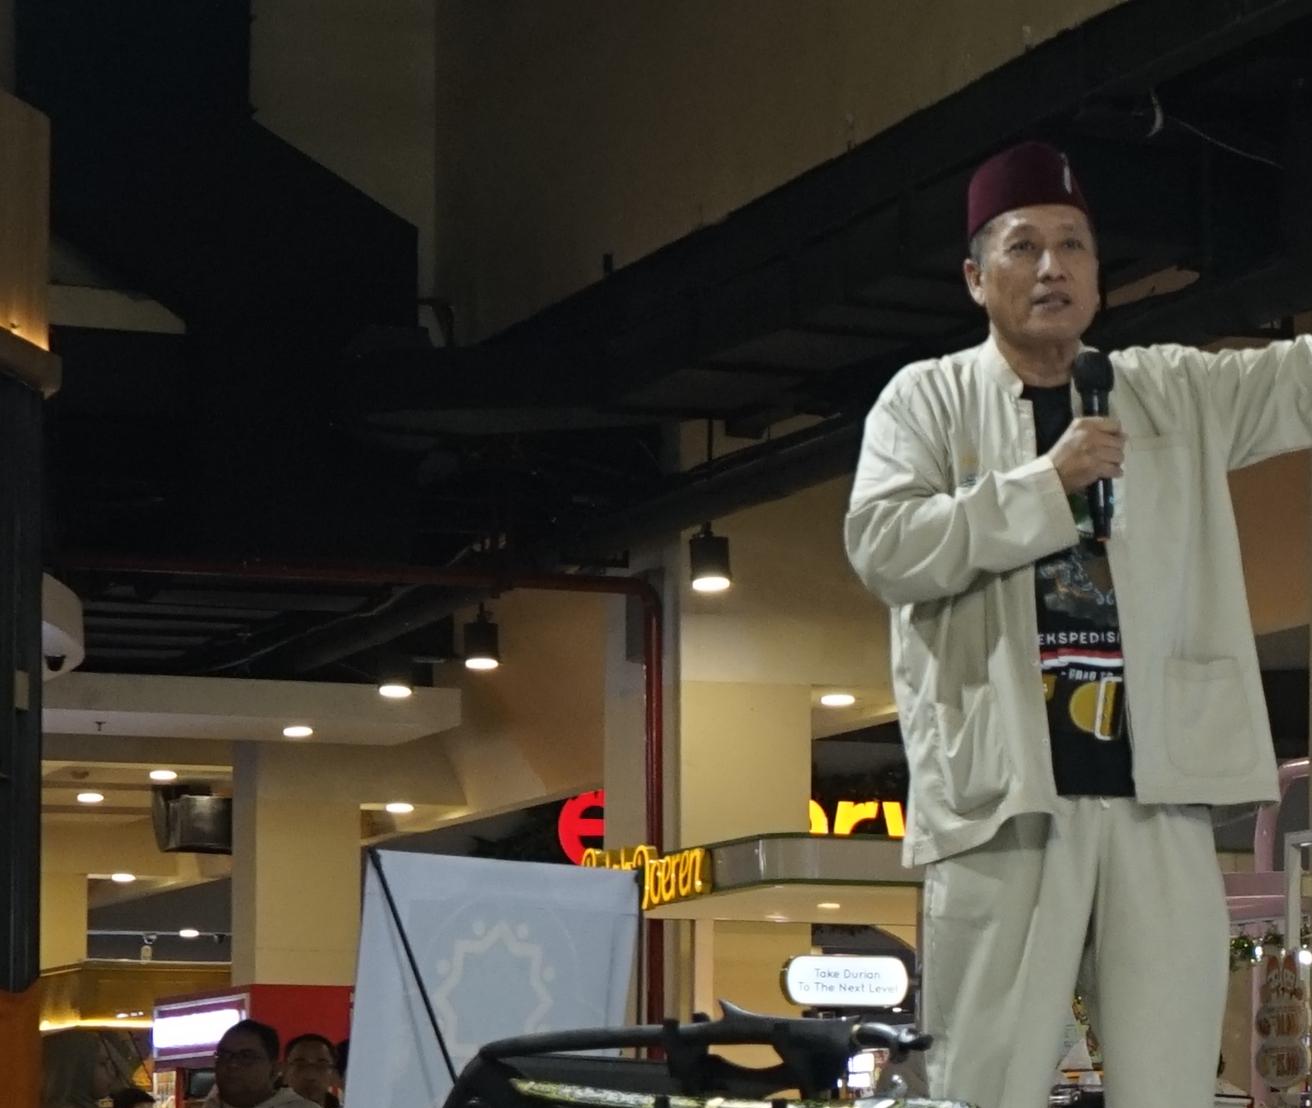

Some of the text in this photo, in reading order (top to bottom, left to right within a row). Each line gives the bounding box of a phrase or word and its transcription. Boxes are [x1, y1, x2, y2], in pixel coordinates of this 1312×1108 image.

[814, 968, 881, 979] Take Durian
[798, 981, 898, 993] To The Next Level
